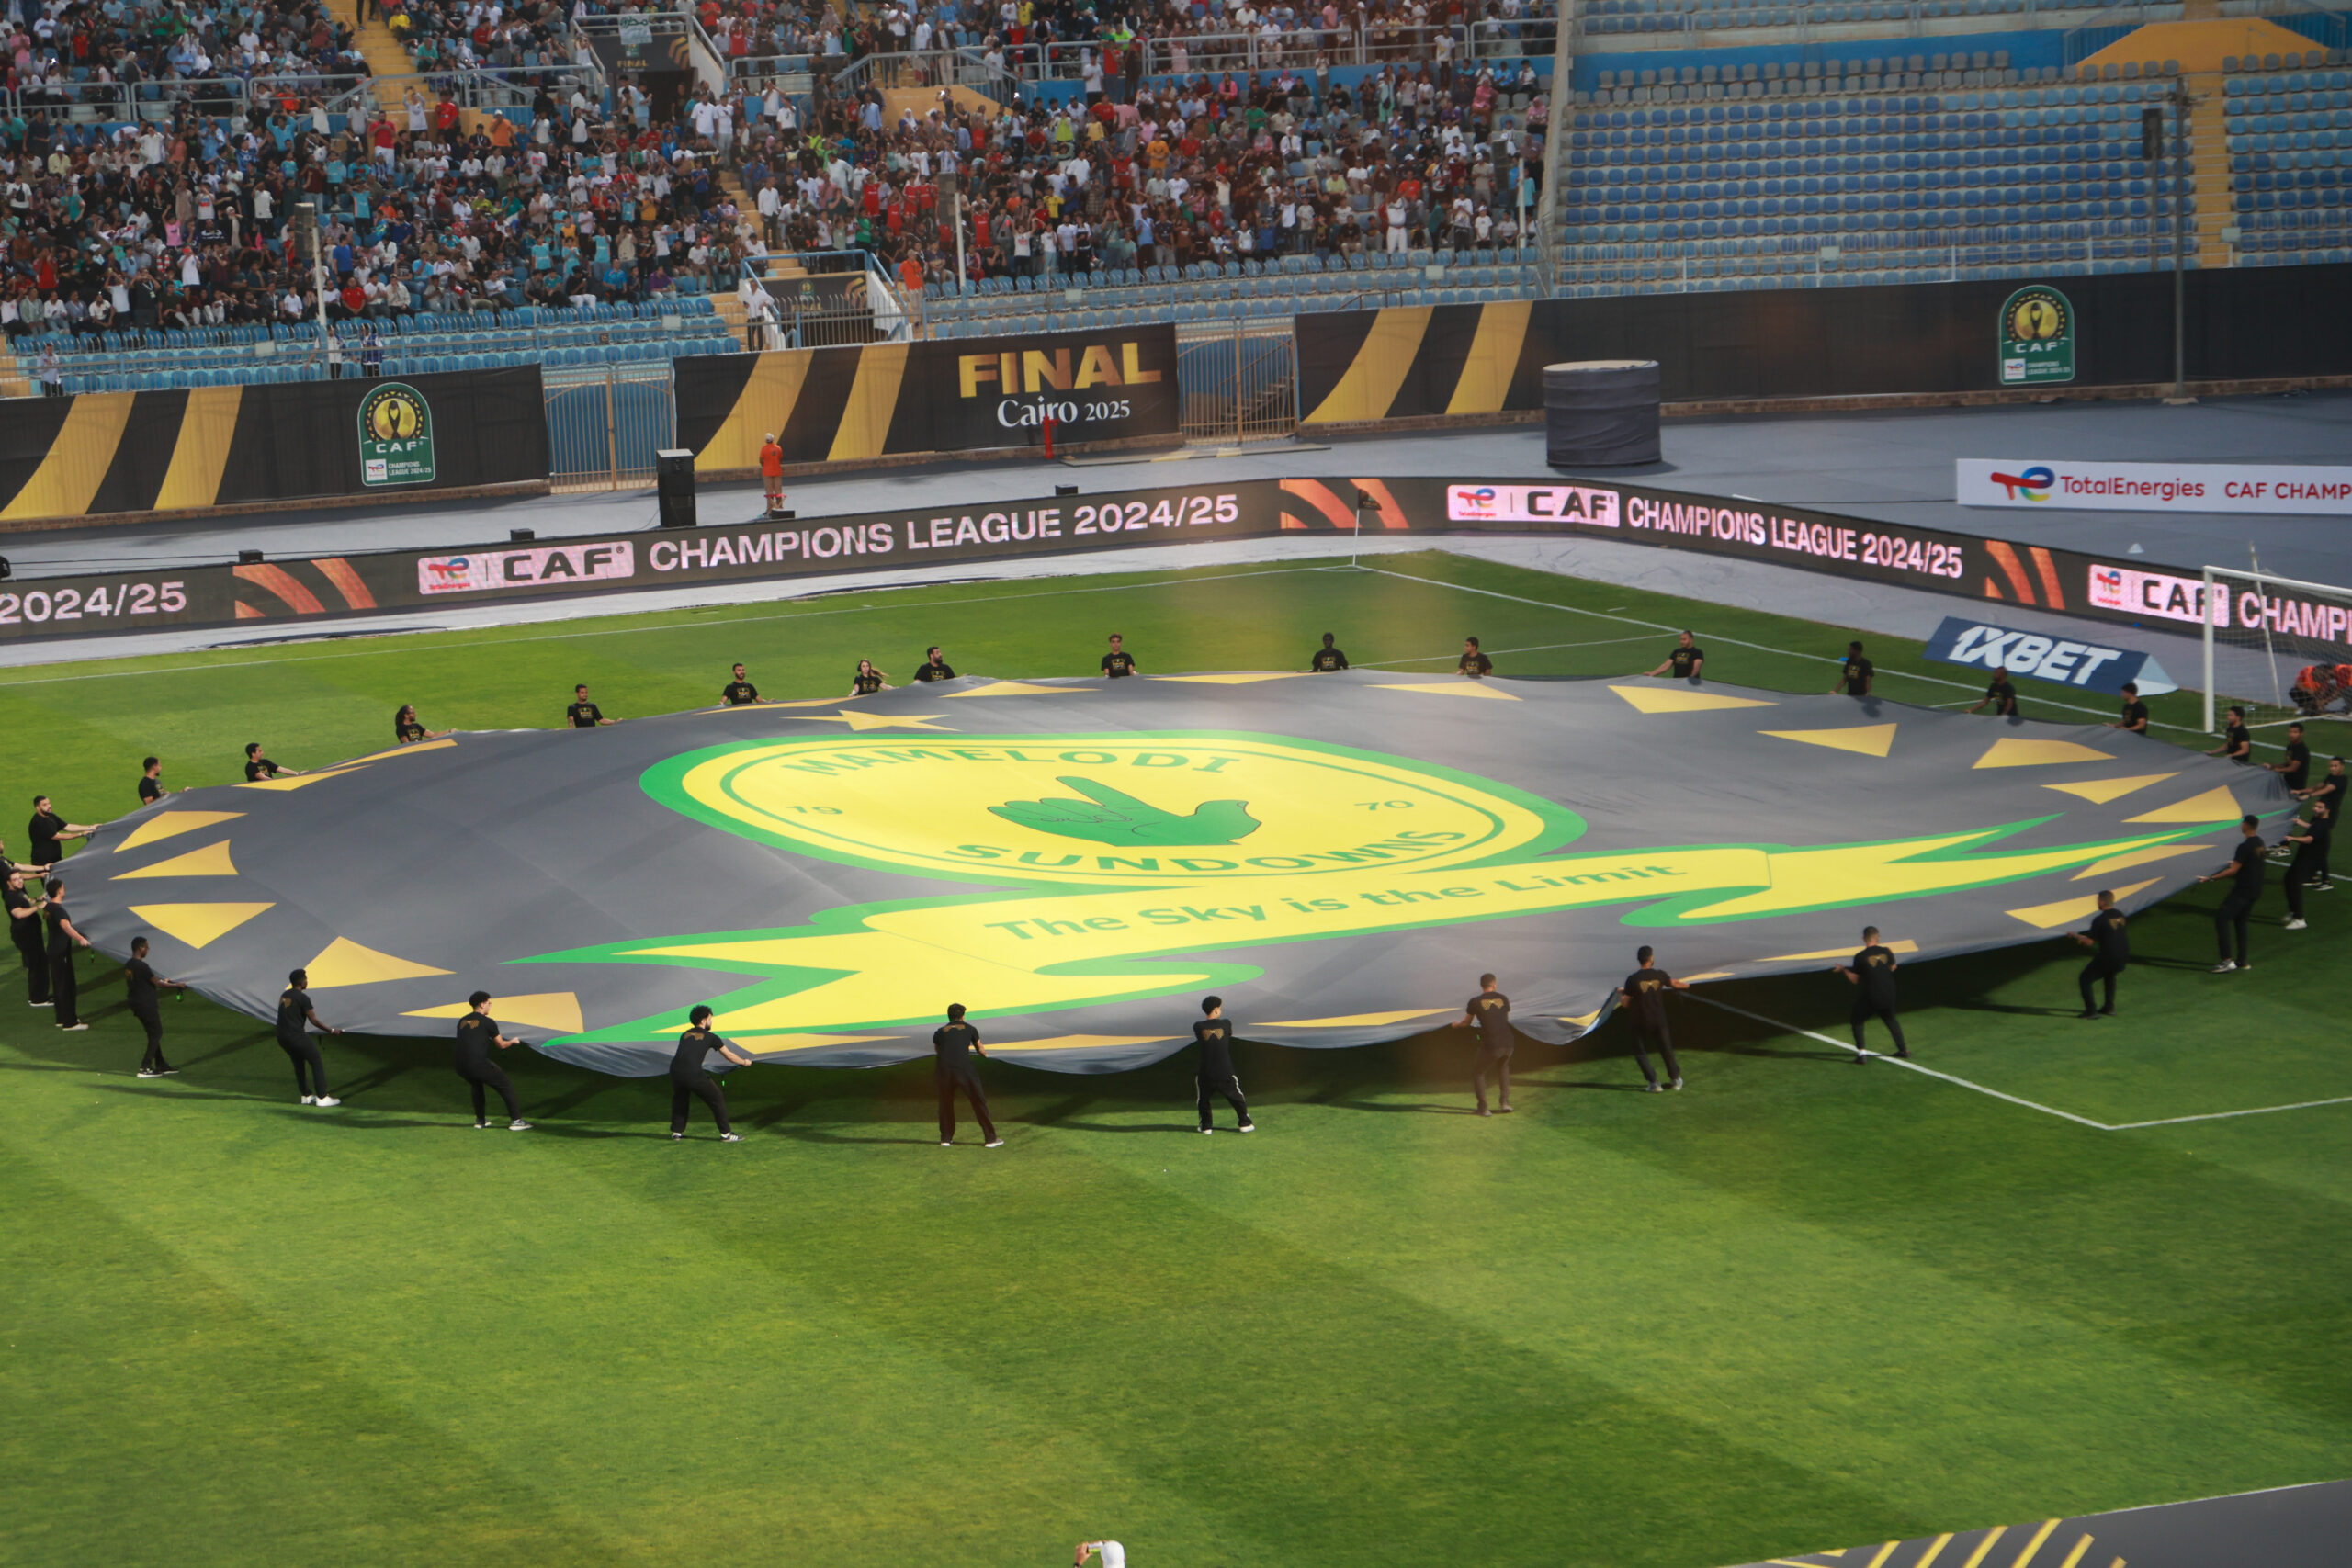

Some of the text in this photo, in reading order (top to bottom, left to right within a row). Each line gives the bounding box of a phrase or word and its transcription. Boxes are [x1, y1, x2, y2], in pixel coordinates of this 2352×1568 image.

[2015, 342, 2058, 353] CAF
[958, 342, 1161, 398] FINAL
[997, 395, 1131, 428] Cairo 2025
[376, 441, 417, 453] CAF
[2060, 476, 2205, 502] TotalEnergies
[2224, 481, 2267, 499] CAF
[503, 494, 1239, 581] CAF CHAMPIONS LEAGUE 2024/25
[1527, 491, 1963, 579] CAF CHAMPIONS LEAGUE 2024/25
[0, 581, 187, 625] 2024/25
[1947, 625, 2123, 685] 1XBET
[779, 748, 1242, 777] MAMELODI
[1353, 800, 1415, 811] 70
[943, 829, 1468, 872] SUNDOWNS
[984, 864, 1689, 940] The Sky is the Limit
